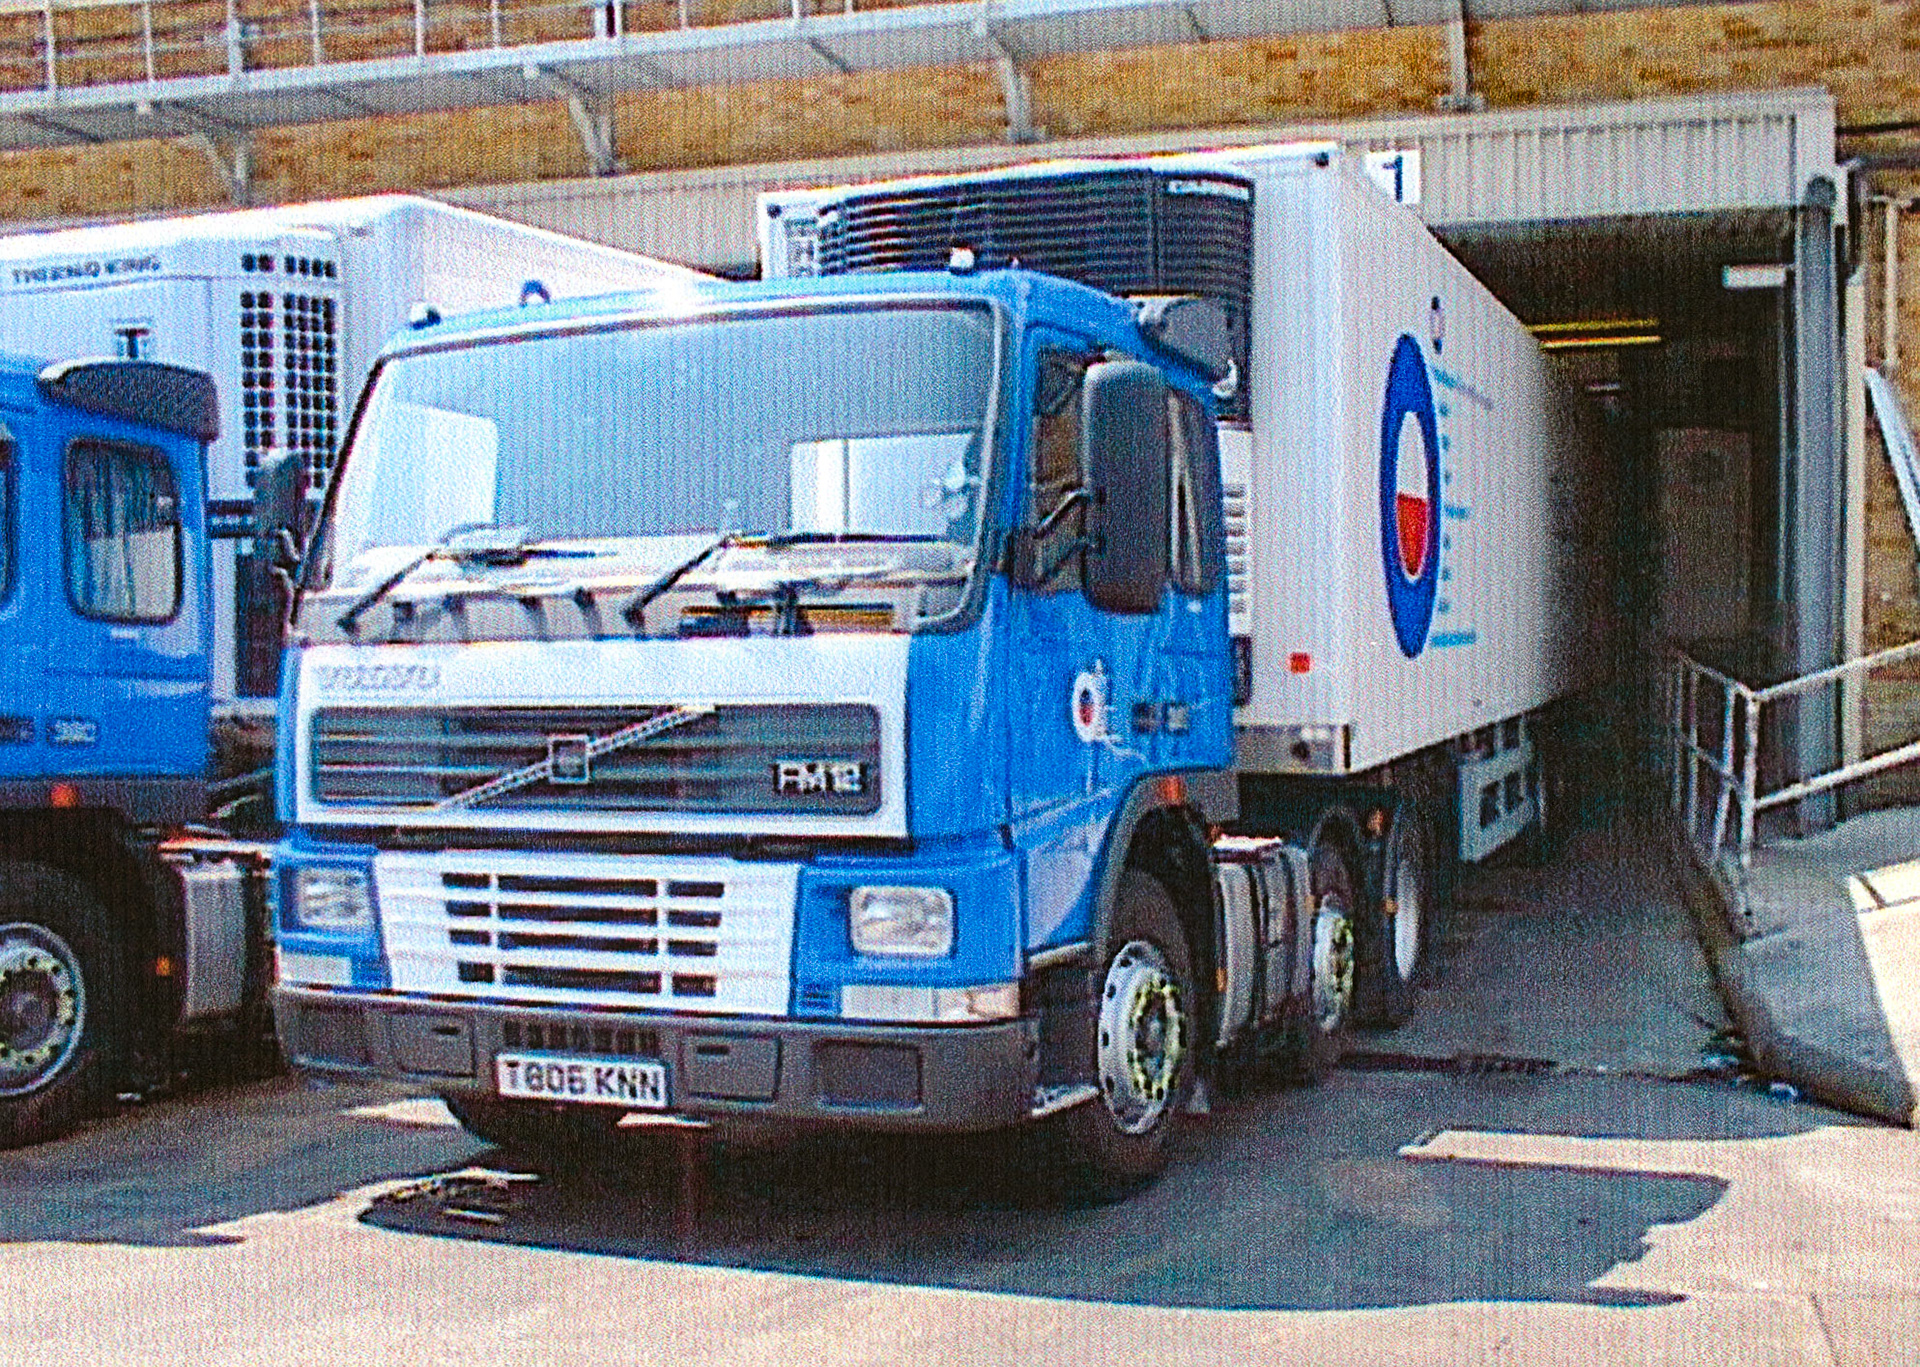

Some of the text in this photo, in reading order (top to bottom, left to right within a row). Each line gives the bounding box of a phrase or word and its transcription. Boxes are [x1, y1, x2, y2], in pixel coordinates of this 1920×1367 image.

[1382, 154, 1403, 203] 1
[779, 761, 862, 792] FM12
[594, 1067, 659, 1100] KNN
